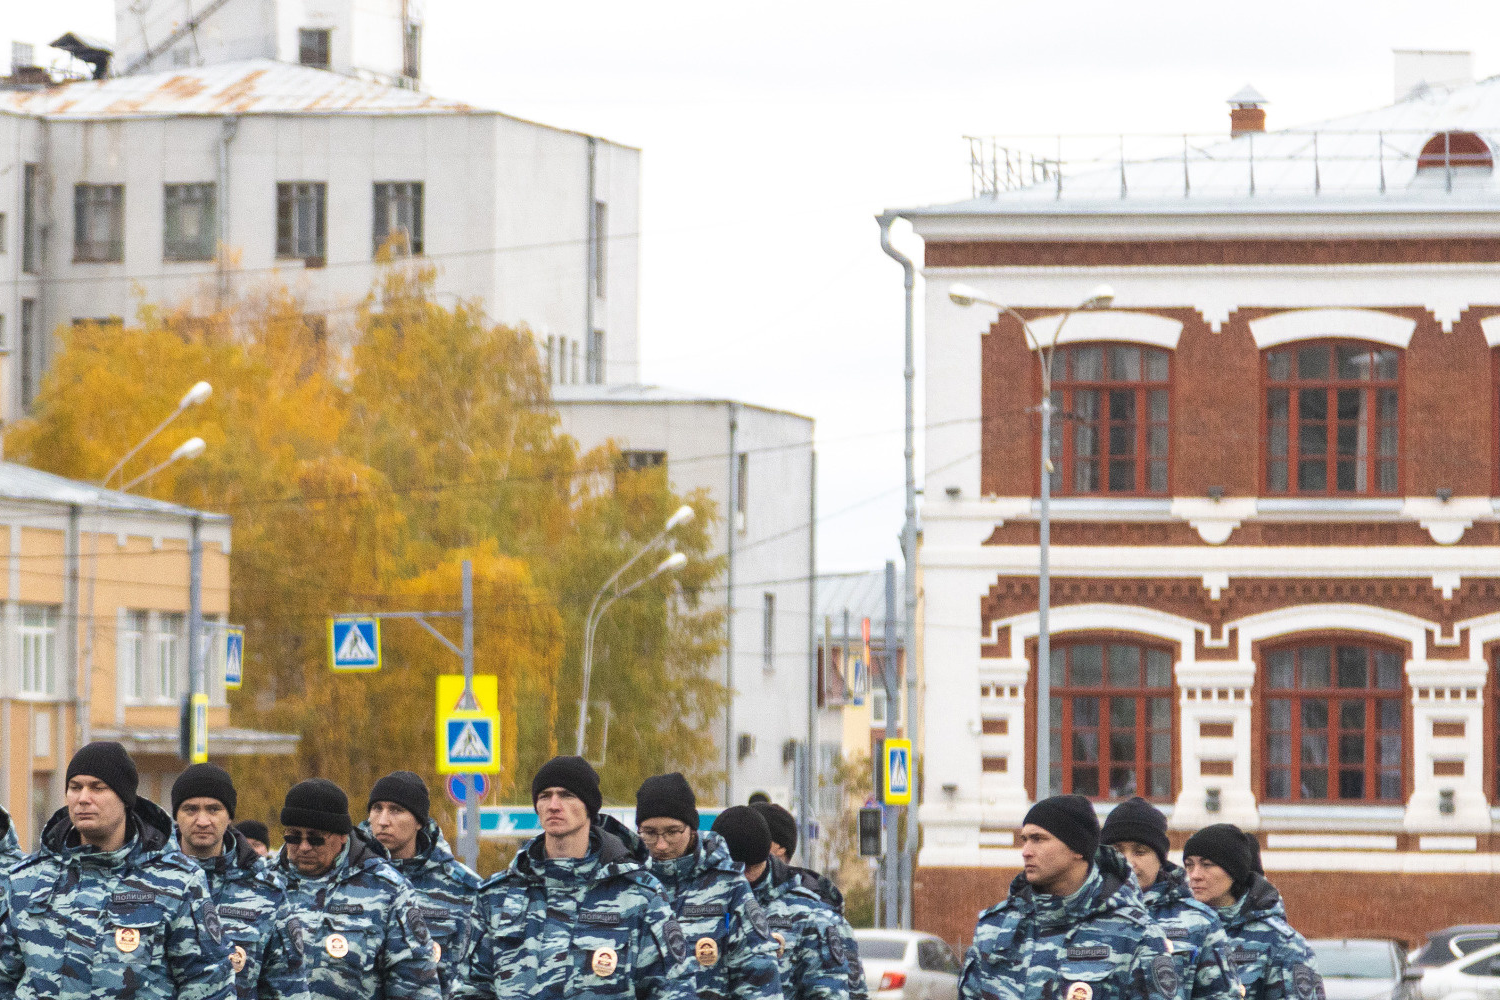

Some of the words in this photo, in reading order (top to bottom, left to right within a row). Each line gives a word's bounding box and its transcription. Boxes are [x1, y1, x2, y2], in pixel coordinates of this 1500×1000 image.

[115, 893, 152, 901] ПОЛИЦИЯ
[221, 906, 254, 917] ПОЛИЦИЯ
[687, 905, 721, 914] ПОЛИЦИЯ
[581, 913, 618, 923] ПОЛИЦИЯ
[1070, 948, 1109, 957] ПОЛИЦИЯ
